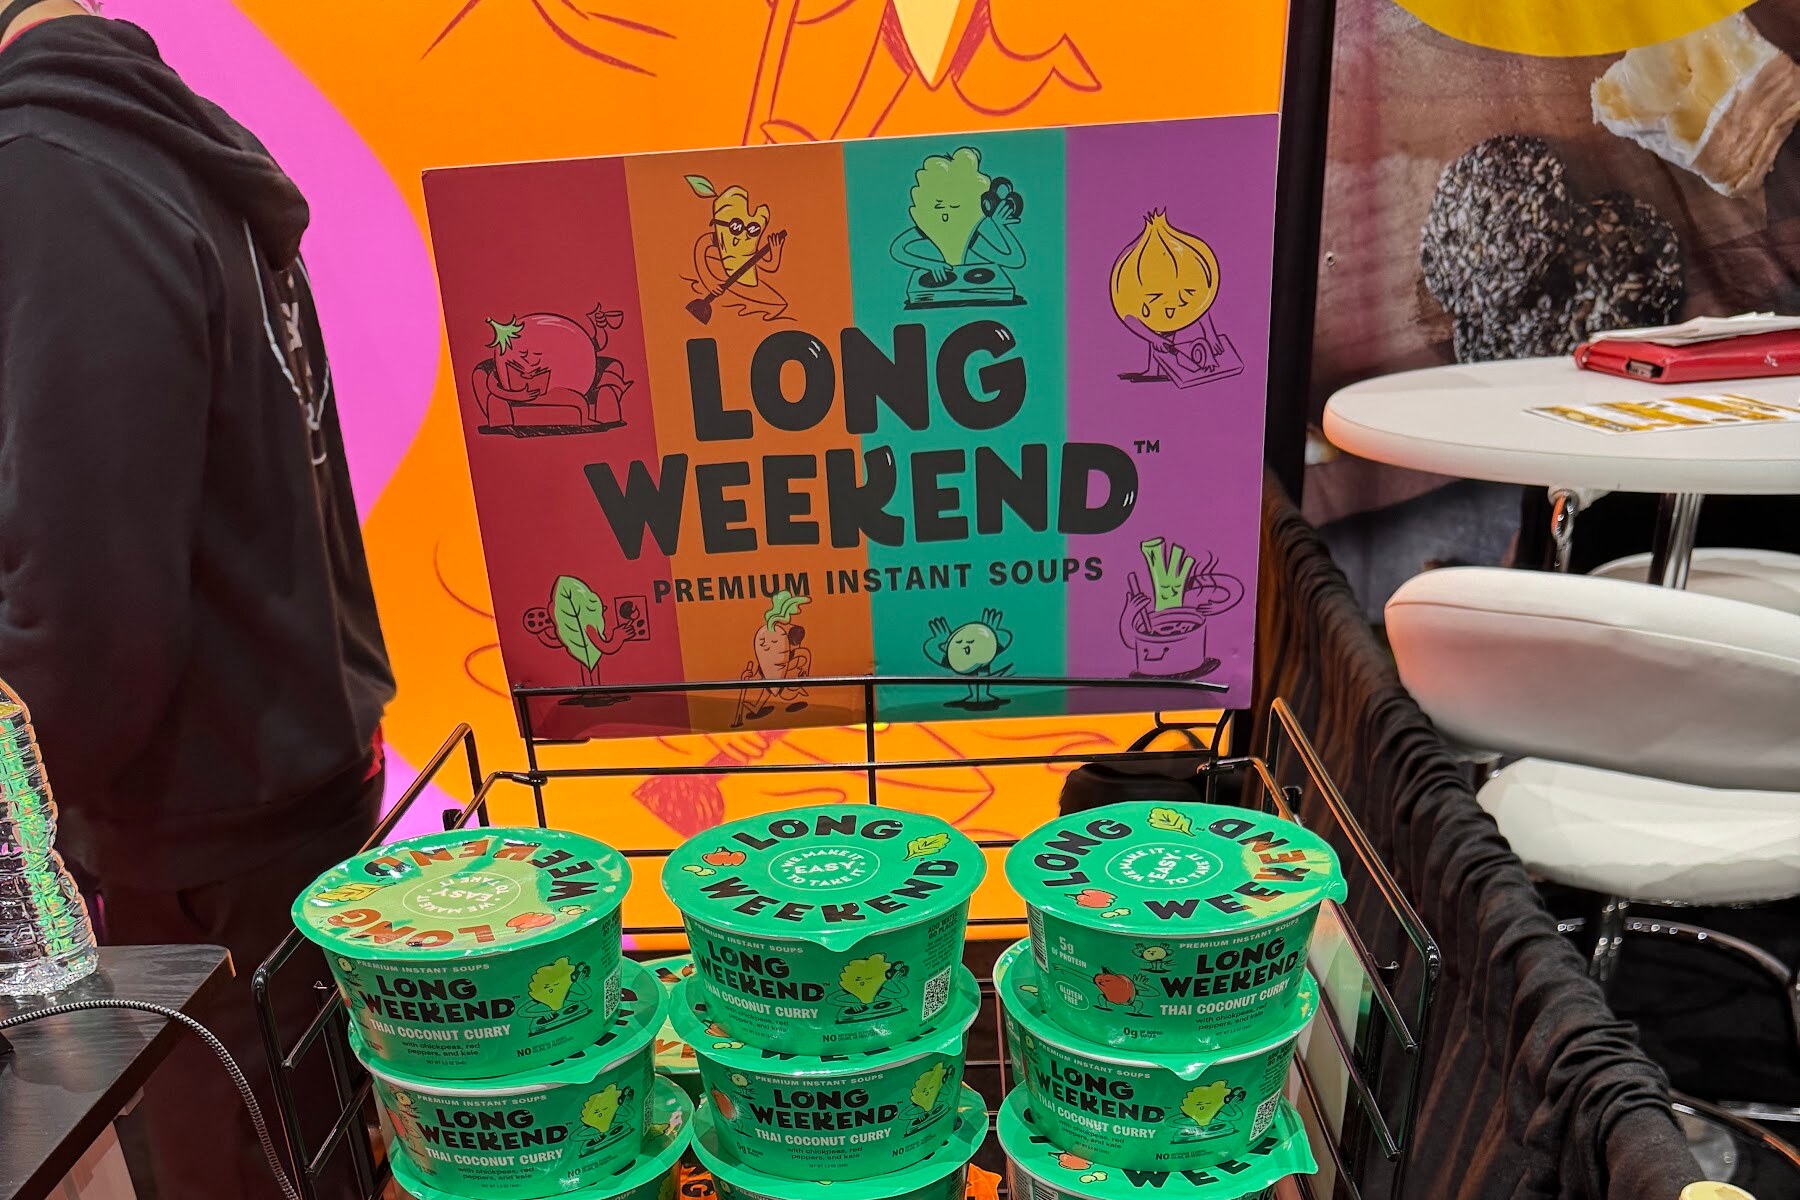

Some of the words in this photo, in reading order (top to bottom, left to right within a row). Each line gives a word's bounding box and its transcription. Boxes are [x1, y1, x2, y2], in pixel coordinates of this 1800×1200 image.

[686, 319, 1027, 443] LONG
[584, 440, 1138, 561] WEEKEND
[653, 570, 811, 604] PREMIUM
[825, 561, 971, 596] INSTANT
[989, 555, 1104, 587] SOUPS
[732, 815, 903, 850] LONG
[802, 849, 846, 859] MAKE
[1034, 819, 1132, 887] LONG
[1119, 850, 1148, 871] MAKE
[1152, 852, 1180, 880] EASY
[785, 874, 806, 885] TO
[809, 876, 852, 887] TAKE
[794, 860, 856, 875] EASY
[1143, 818, 1310, 920] WEEKEND
[1168, 876, 1188, 885] TO
[700, 860, 959, 923] WEEKEND
[327, 909, 495, 947] LONG
[694, 922, 724, 940] PREMIUM
[727, 937, 765, 949] INSTANT
[1180, 940, 1228, 948] PREMIUM
[1232, 930, 1272, 944] INSTANT
[1275, 918, 1299, 932] SOUPS
[1059, 936, 1074, 954] 5g
[1196, 936, 1285, 974] LONG
[357, 960, 398, 972] PREMIUM
[452, 963, 490, 972] SOUPS
[707, 939, 790, 979] LONG
[1060, 951, 1086, 968] PROTEIN
[376, 975, 477, 1000] LONG
[697, 954, 824, 1002] WEEKEND
[1160, 951, 1298, 998] WEEKEND
[704, 979, 720, 998] THAI
[721, 991, 771, 1015] COCONUT
[775, 1006, 819, 1019] CURRY
[1060, 984, 1082, 1000] GLUTEN
[1064, 994, 1078, 1006] FREE
[1160, 1005, 1192, 1015] THAI
[1196, 994, 1257, 1014] COCONUT
[1260, 978, 1290, 1000] CURRY
[358, 990, 515, 1023] WEEKEND
[369, 1019, 395, 1035] THAI
[398, 1027, 458, 1041] COCONUT
[464, 1024, 511, 1038] CURRY
[822, 1034, 837, 1042] NO
[1124, 1027, 1138, 1038] 0g
[517, 1048, 531, 1057] NO
[1038, 1042, 1071, 1062] PREMIUM
[1074, 1058, 1113, 1074] INSTANT
[1117, 1069, 1151, 1078] SOUPS
[755, 1075, 799, 1086] PREMIUM
[851, 1074, 884, 1084] SOUPS
[1051, 1060, 1134, 1100] LONG
[417, 1094, 459, 1106] PREMIUM
[512, 1095, 547, 1104] SOUPS
[773, 1088, 869, 1110] LONG
[1035, 1065, 1165, 1123] WEEKEND
[436, 1108, 534, 1130] LONG
[749, 1102, 898, 1131] WEEKEND
[1038, 1092, 1055, 1112] THAI
[1058, 1108, 1110, 1132] COCONUT
[1112, 1124, 1157, 1139] CURRY
[416, 1122, 568, 1151] WEEKEND
[755, 1128, 781, 1143] THAI
[785, 1134, 846, 1147] COCONUT
[850, 1128, 892, 1144] CURRY
[425, 1147, 451, 1162] THAI
[454, 1154, 514, 1166] COCONUT
[519, 1149, 563, 1164] CURRY
[1156, 1152, 1169, 1160] NO
